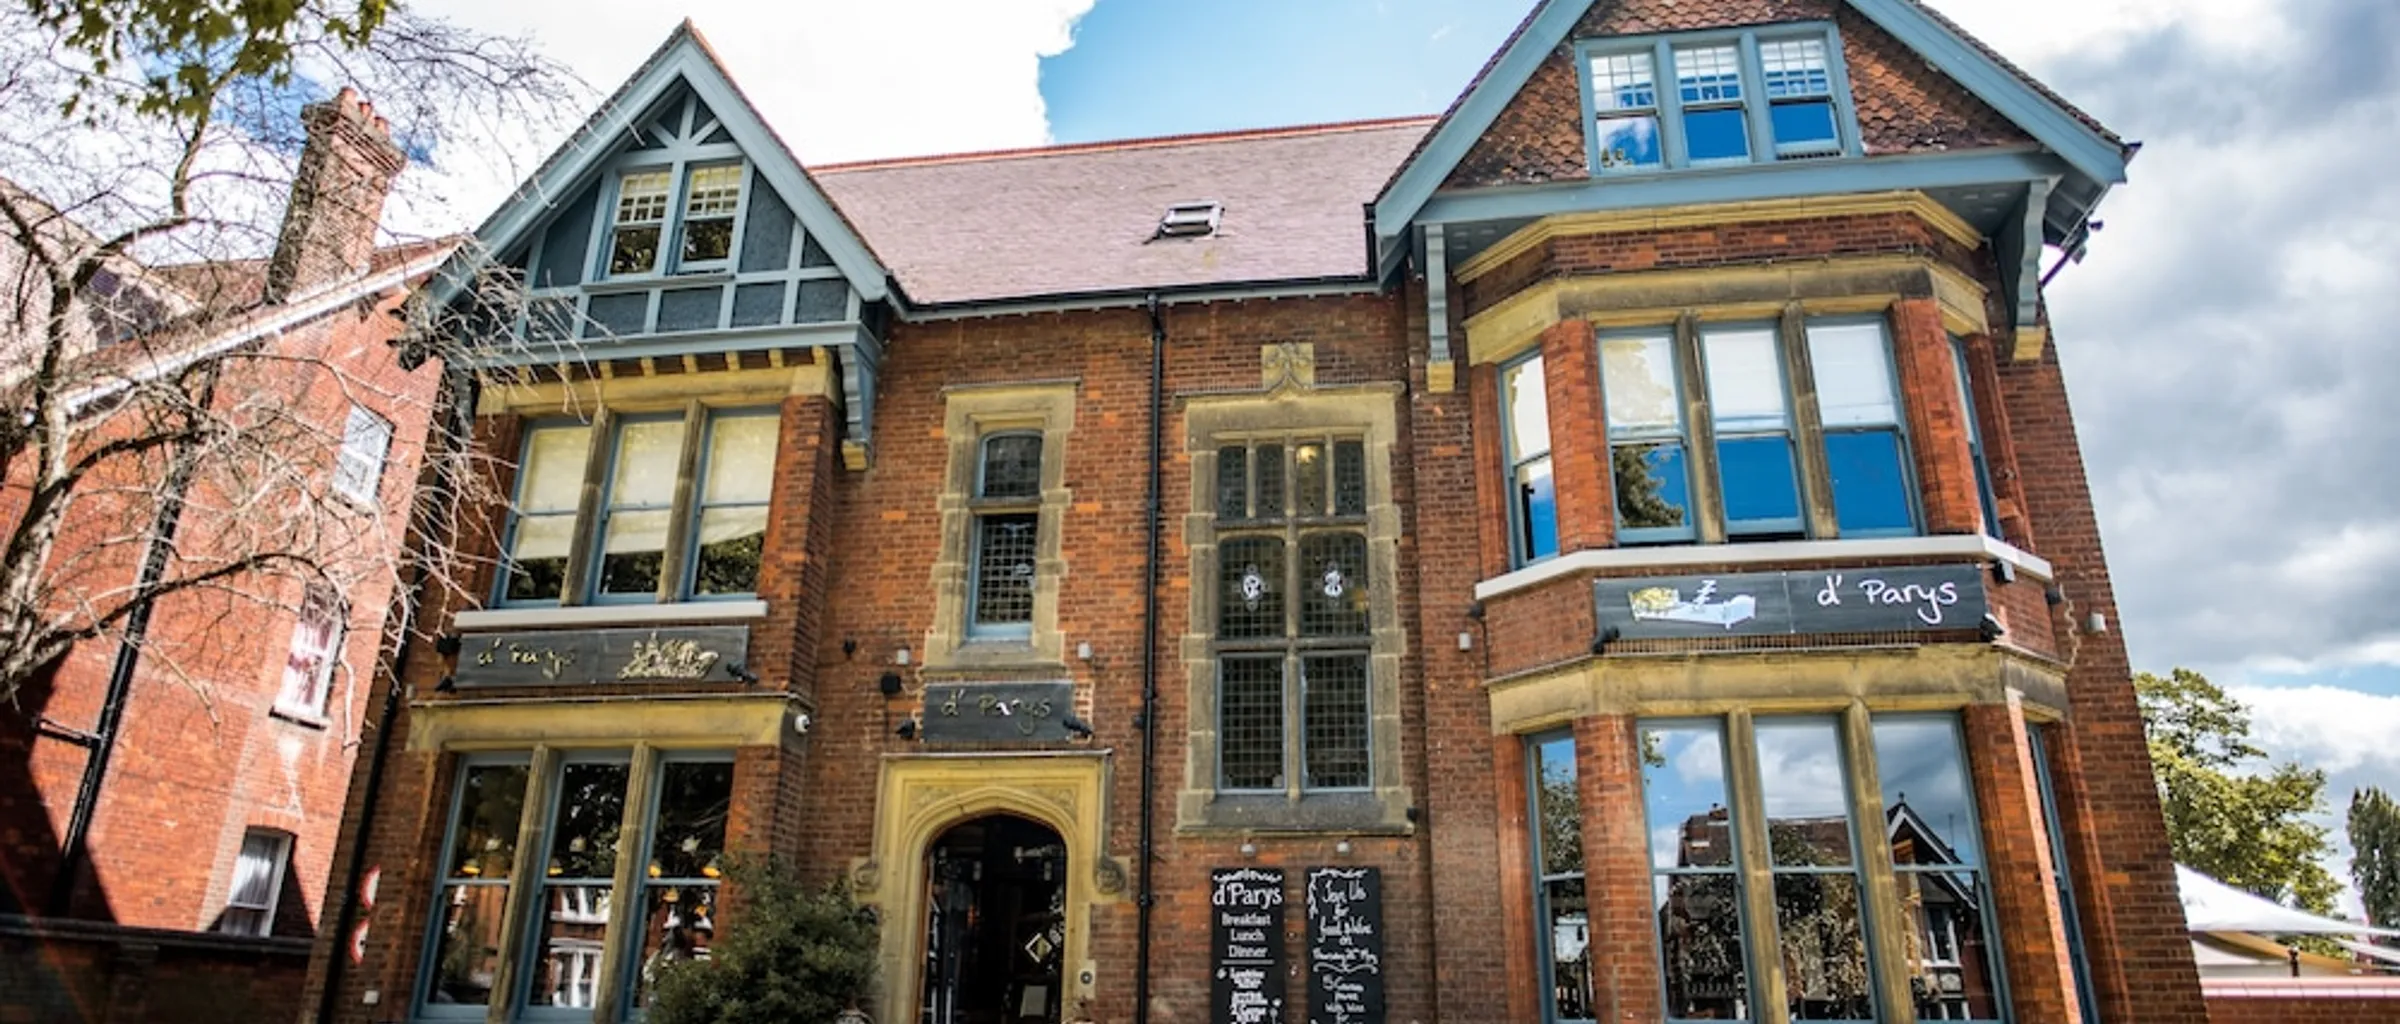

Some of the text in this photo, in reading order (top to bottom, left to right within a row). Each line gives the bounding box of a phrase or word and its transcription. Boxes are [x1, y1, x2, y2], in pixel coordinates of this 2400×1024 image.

[1817, 573, 1958, 625] d' Parys
[977, 693, 1051, 735] Parys
[1221, 912, 1272, 927] Breakfast
[1229, 927, 1266, 942] Lunch
[1228, 944, 1269, 959] Dinner
